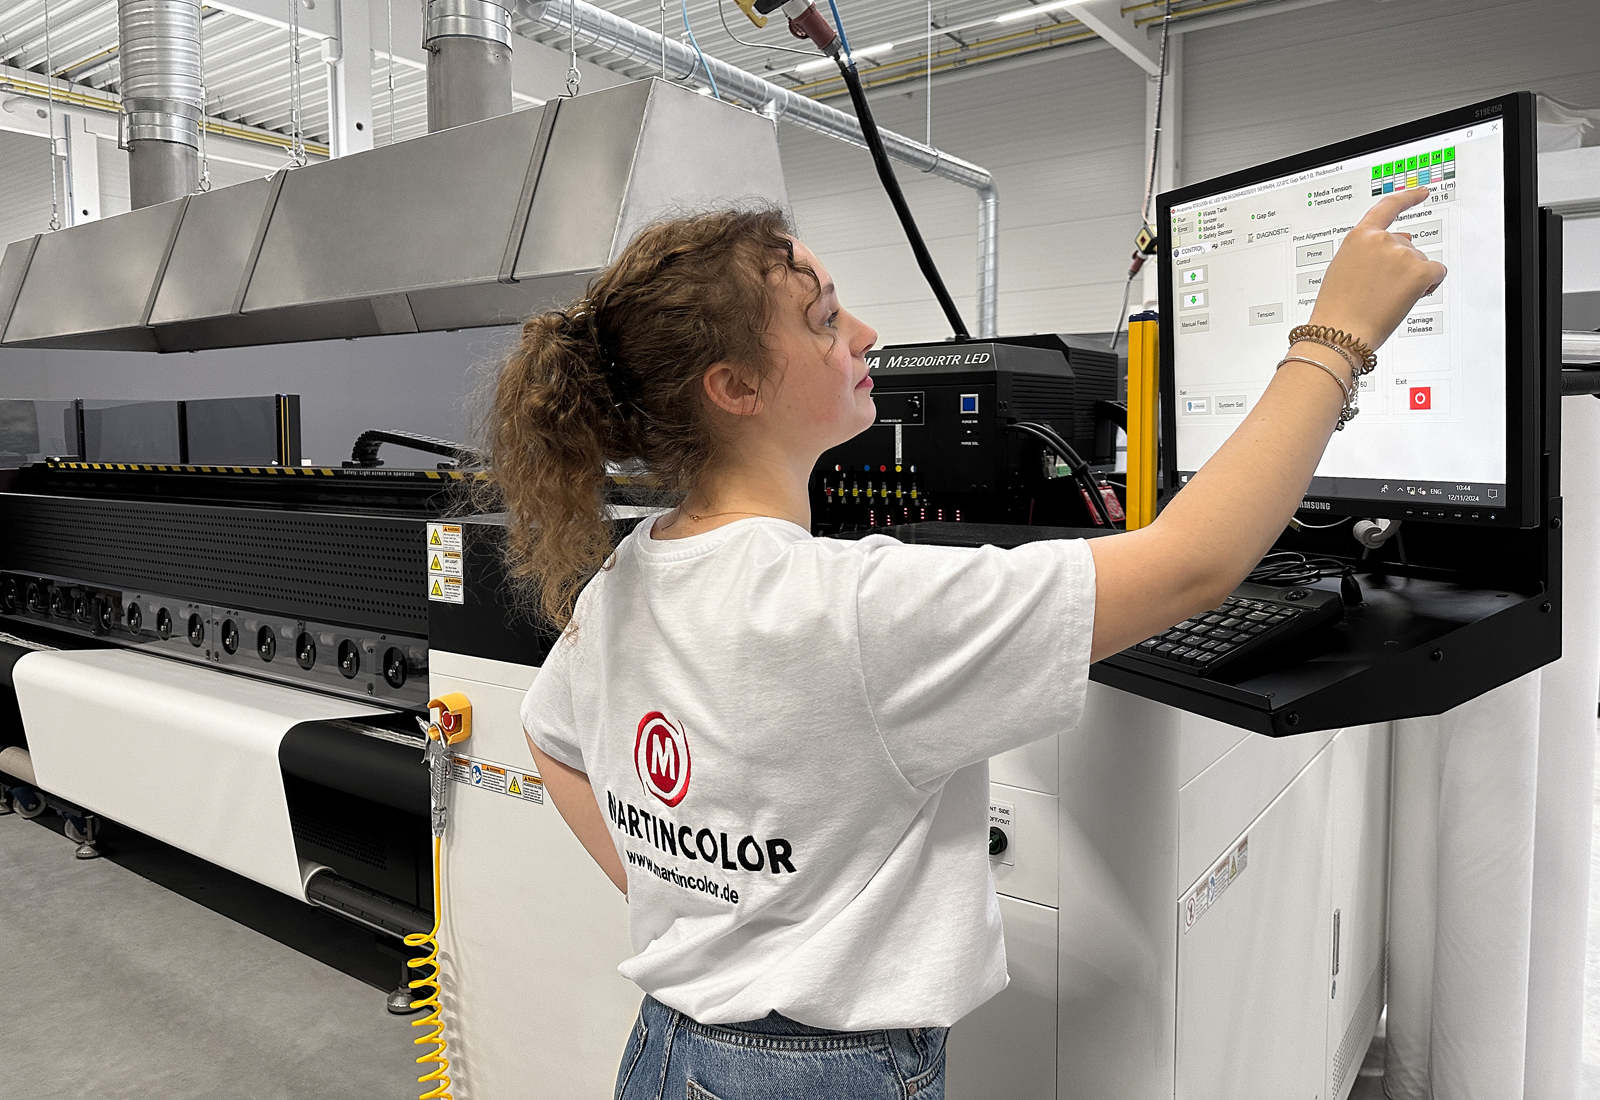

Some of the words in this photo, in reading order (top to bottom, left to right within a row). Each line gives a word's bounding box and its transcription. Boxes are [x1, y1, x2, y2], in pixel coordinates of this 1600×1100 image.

[1313, 190, 1329, 198] Media
[1331, 184, 1352, 193] Tension
[1441, 181, 1456, 191] L(m)
[1314, 197, 1334, 206] Tension
[1431, 193, 1448, 202] 19.16
[1203, 209, 1216, 217] Waste
[1217, 206, 1227, 214] Tank
[1203, 224, 1216, 232] Media
[1203, 231, 1216, 239] Safety
[1218, 229, 1233, 237] Sensor
[1256, 227, 1289, 240] DIAGNOSTIC
[1305, 229, 1331, 240] Alignment
[1420, 229, 1439, 238] Cover
[1220, 239, 1235, 247] PRINT
[1407, 317, 1433, 325] Carriage
[886, 354, 961, 368] M3200iRTR
[964, 353, 990, 365] LED
[1447, 494, 1479, 502] 12/11/2024
[1299, 501, 1330, 510] AMSUNG
[651, 733, 675, 780] M
[607, 790, 797, 874] MARTINCOLOR
[626, 850, 739, 904] www.martincolor.de
